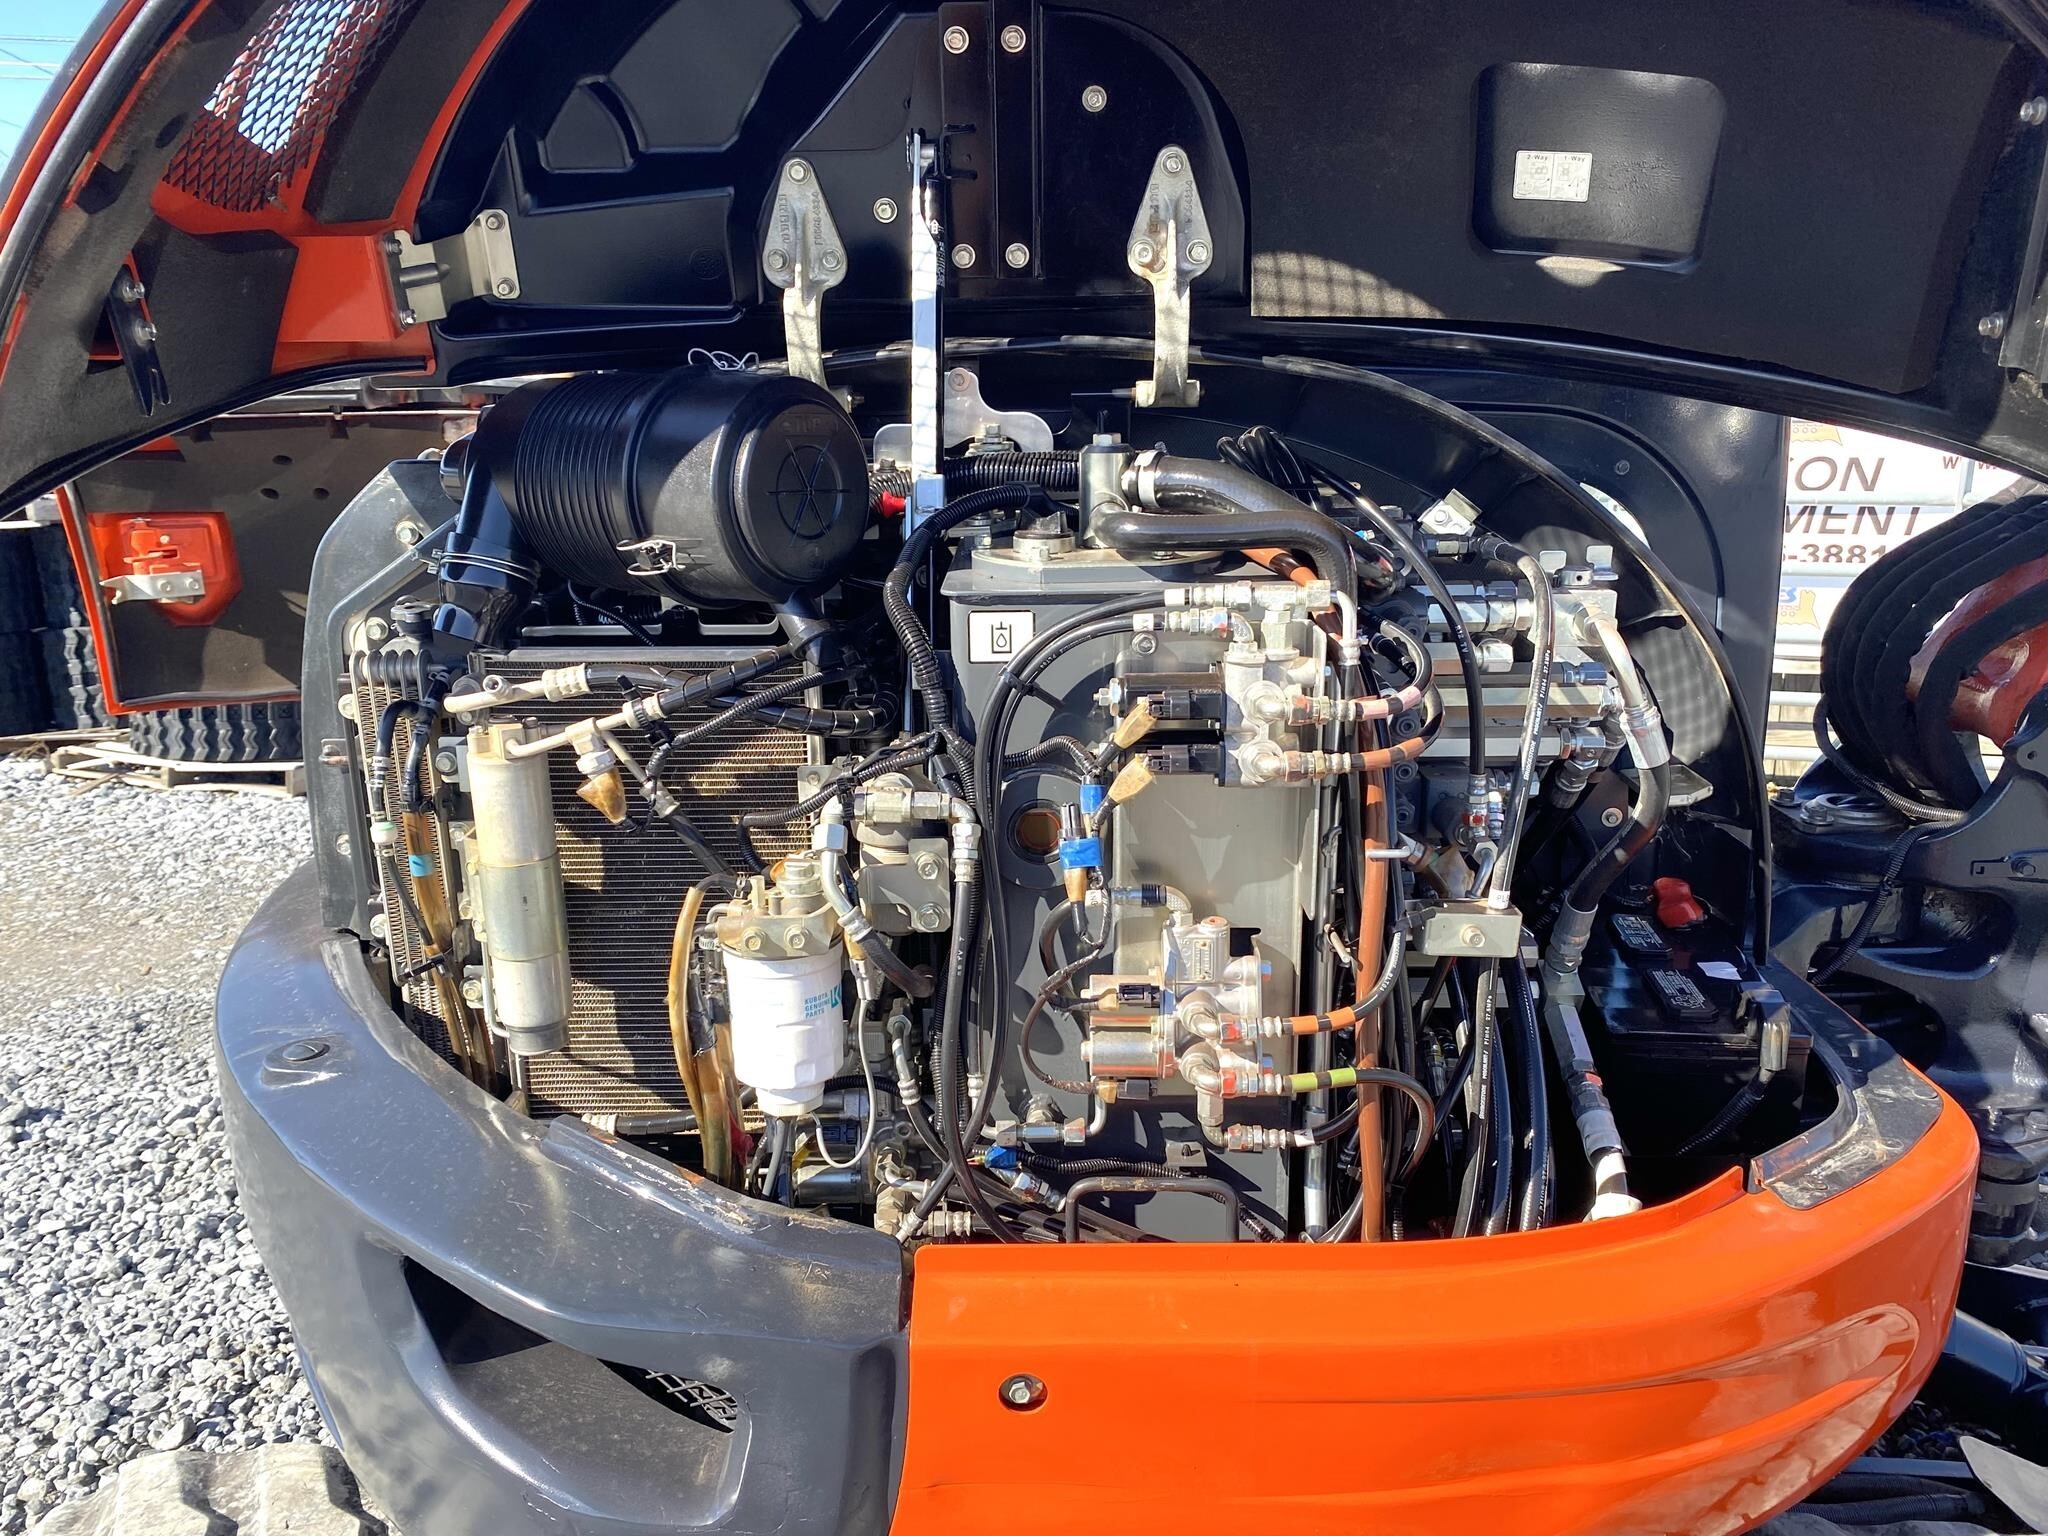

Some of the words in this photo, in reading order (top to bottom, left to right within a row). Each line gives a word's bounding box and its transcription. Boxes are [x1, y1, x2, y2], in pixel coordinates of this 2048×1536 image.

[1783, 543, 1887, 564] -3881
[1523, 740, 1537, 780] BRIDGESTONE
[804, 992, 829, 1005] KUBOTA
[805, 1007, 825, 1019] PARTS
